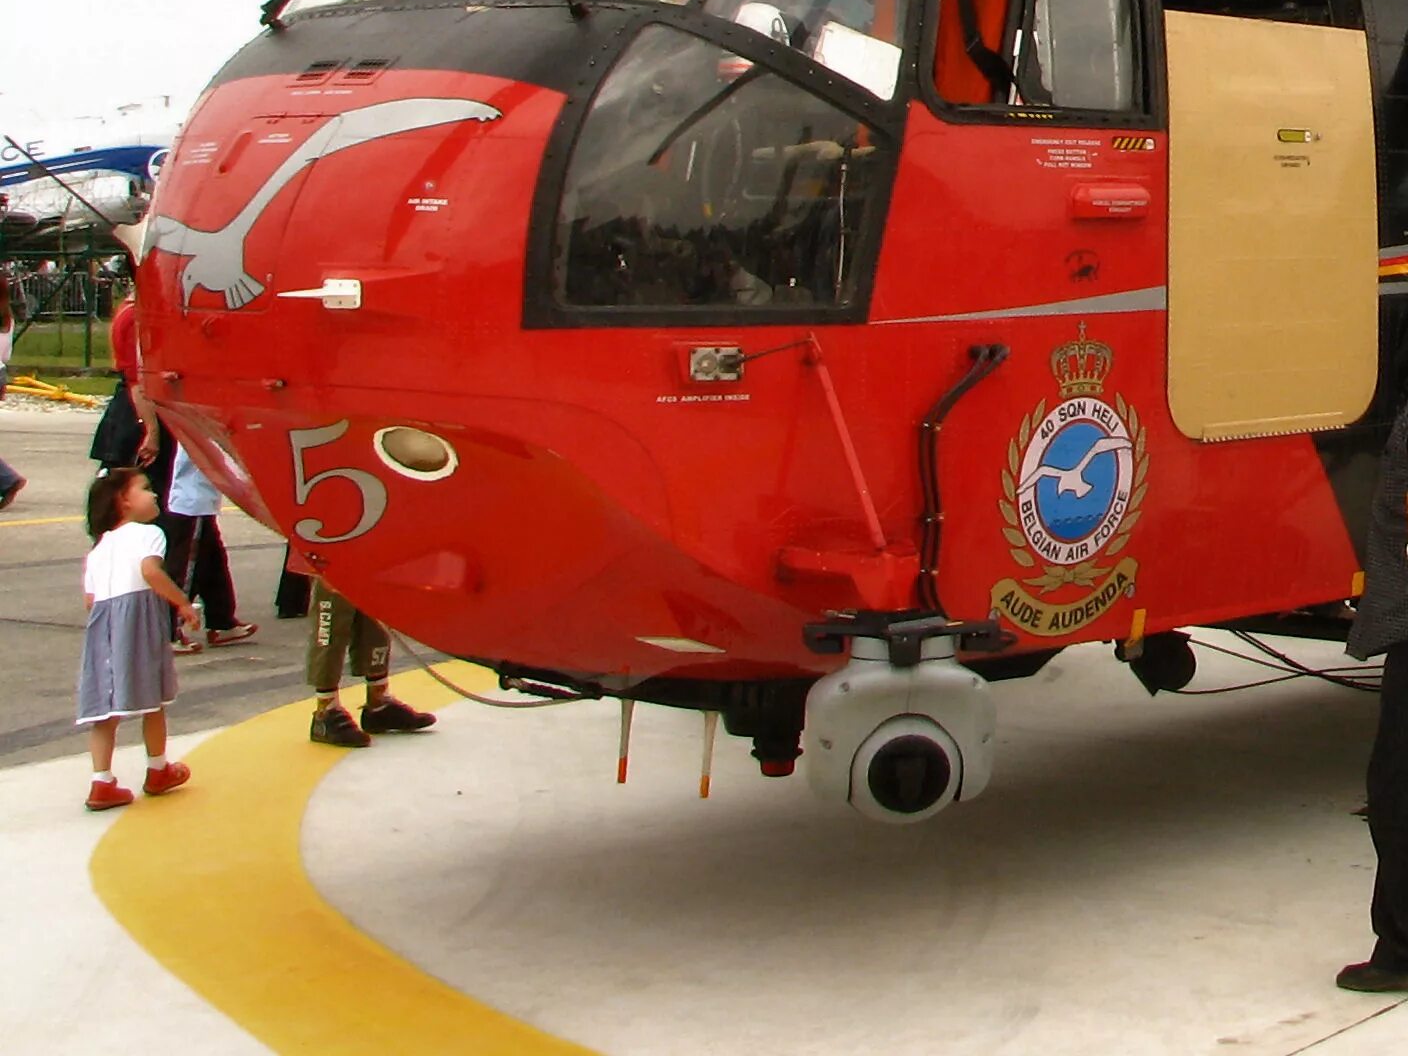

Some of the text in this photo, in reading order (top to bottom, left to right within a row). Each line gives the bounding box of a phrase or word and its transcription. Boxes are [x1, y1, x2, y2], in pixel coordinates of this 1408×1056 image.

[1040, 400, 1120, 440] 40 SQN HELI
[289, 418, 389, 544] 5
[1020, 490, 1129, 563] BELGIAN AIR FORCE
[1000, 571, 1130, 631] AUDE AUDENDA
[371, 646, 388, 666] 57
